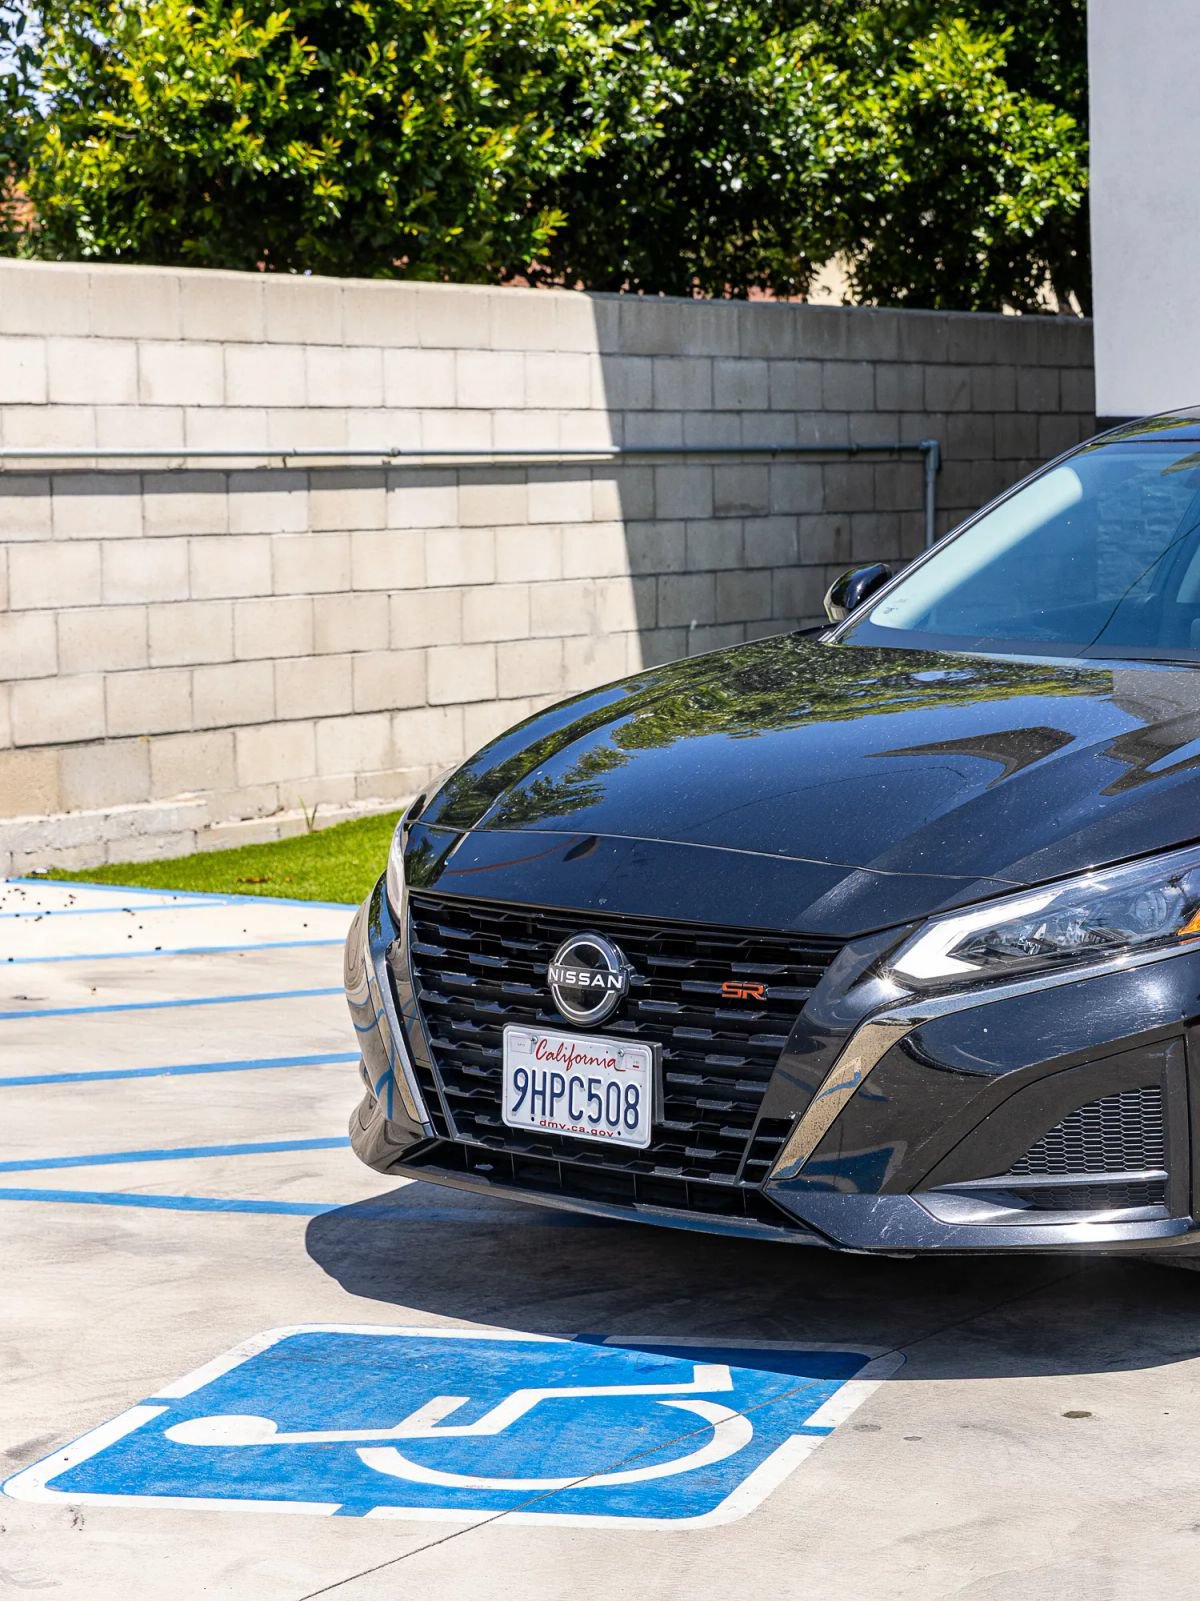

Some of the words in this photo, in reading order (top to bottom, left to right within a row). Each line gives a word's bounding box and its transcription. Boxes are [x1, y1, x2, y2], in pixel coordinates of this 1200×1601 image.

[548, 966, 624, 990] NISSAN
[721, 980, 765, 1000] SR
[535, 1038, 626, 1072] California
[511, 1067, 640, 1130] 9HPC508
[539, 1119, 614, 1138] dmv.ca.gov
